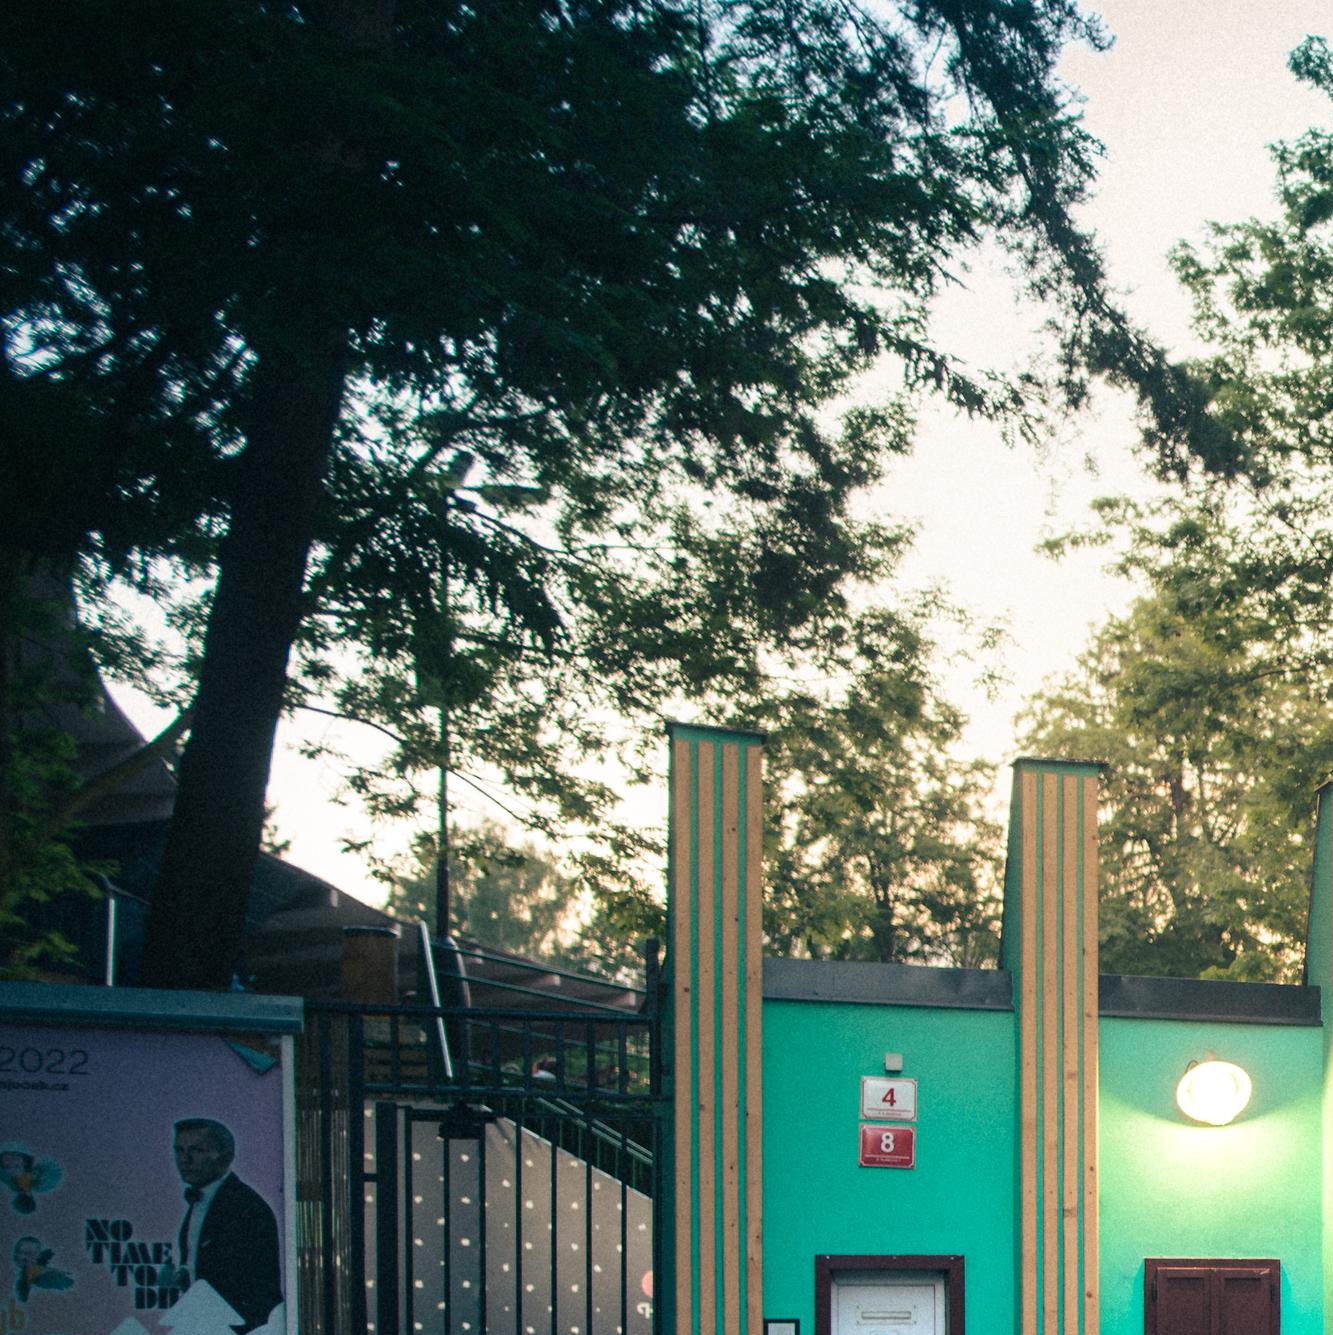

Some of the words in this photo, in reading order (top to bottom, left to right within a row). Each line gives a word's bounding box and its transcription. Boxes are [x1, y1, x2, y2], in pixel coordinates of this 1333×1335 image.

[882, 1088, 896, 1107] 4
[881, 1132, 895, 1153] 8
[85, 1219, 133, 1241] NO
[86, 1242, 172, 1265] TIME
[110, 1265, 158, 1286] TO
